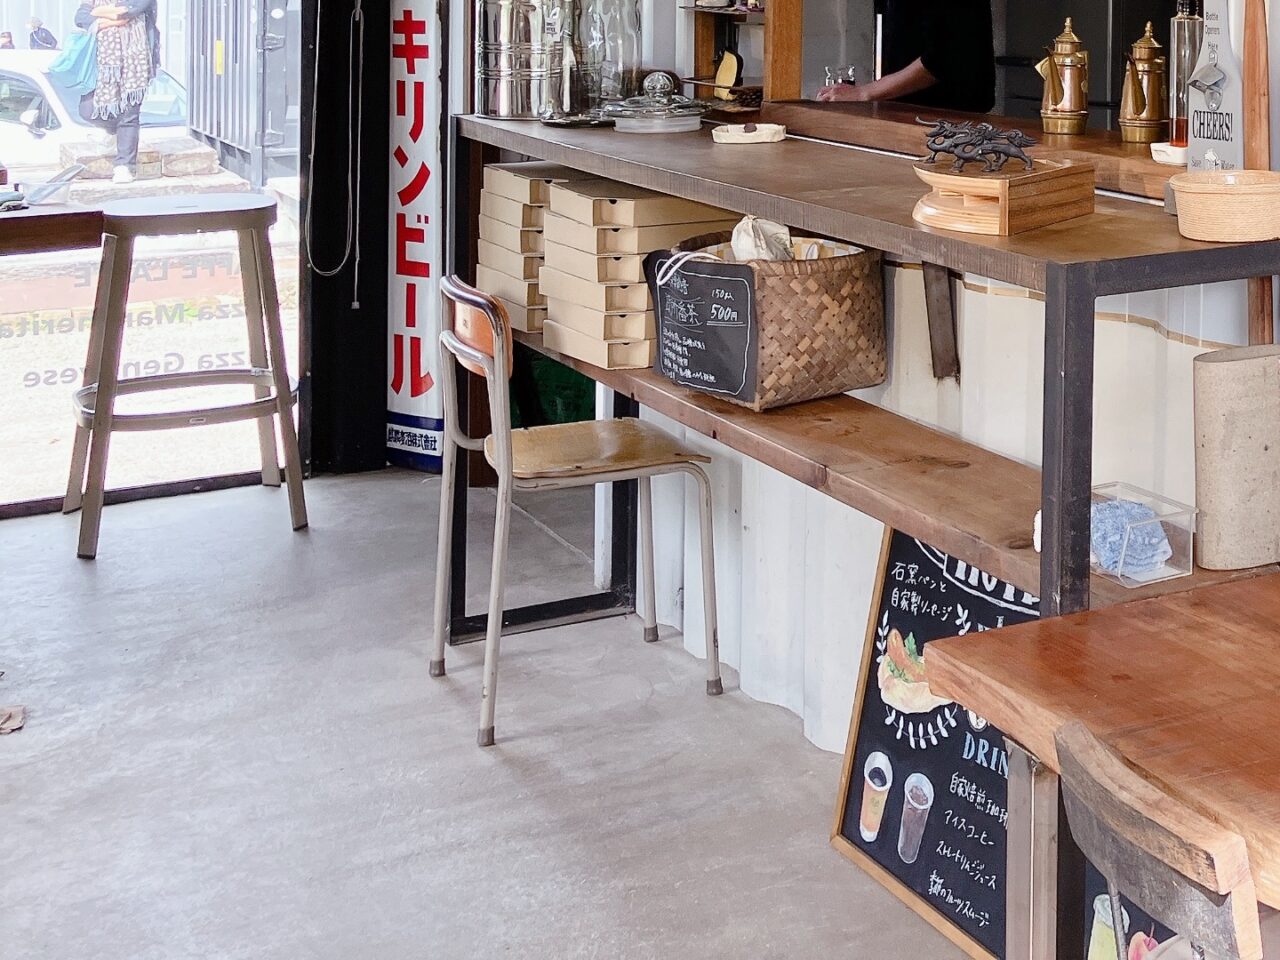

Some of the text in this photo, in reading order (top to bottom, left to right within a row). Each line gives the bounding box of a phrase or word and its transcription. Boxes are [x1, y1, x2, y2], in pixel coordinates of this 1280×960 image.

[1192, 110, 1233, 142] CHEERS!
[390, 9, 434, 398] キリンビール
[710, 303, 738, 322] 500円
[962, 731, 1009, 780] DRIN
[944, 809, 996, 846] アイスコーヒー
